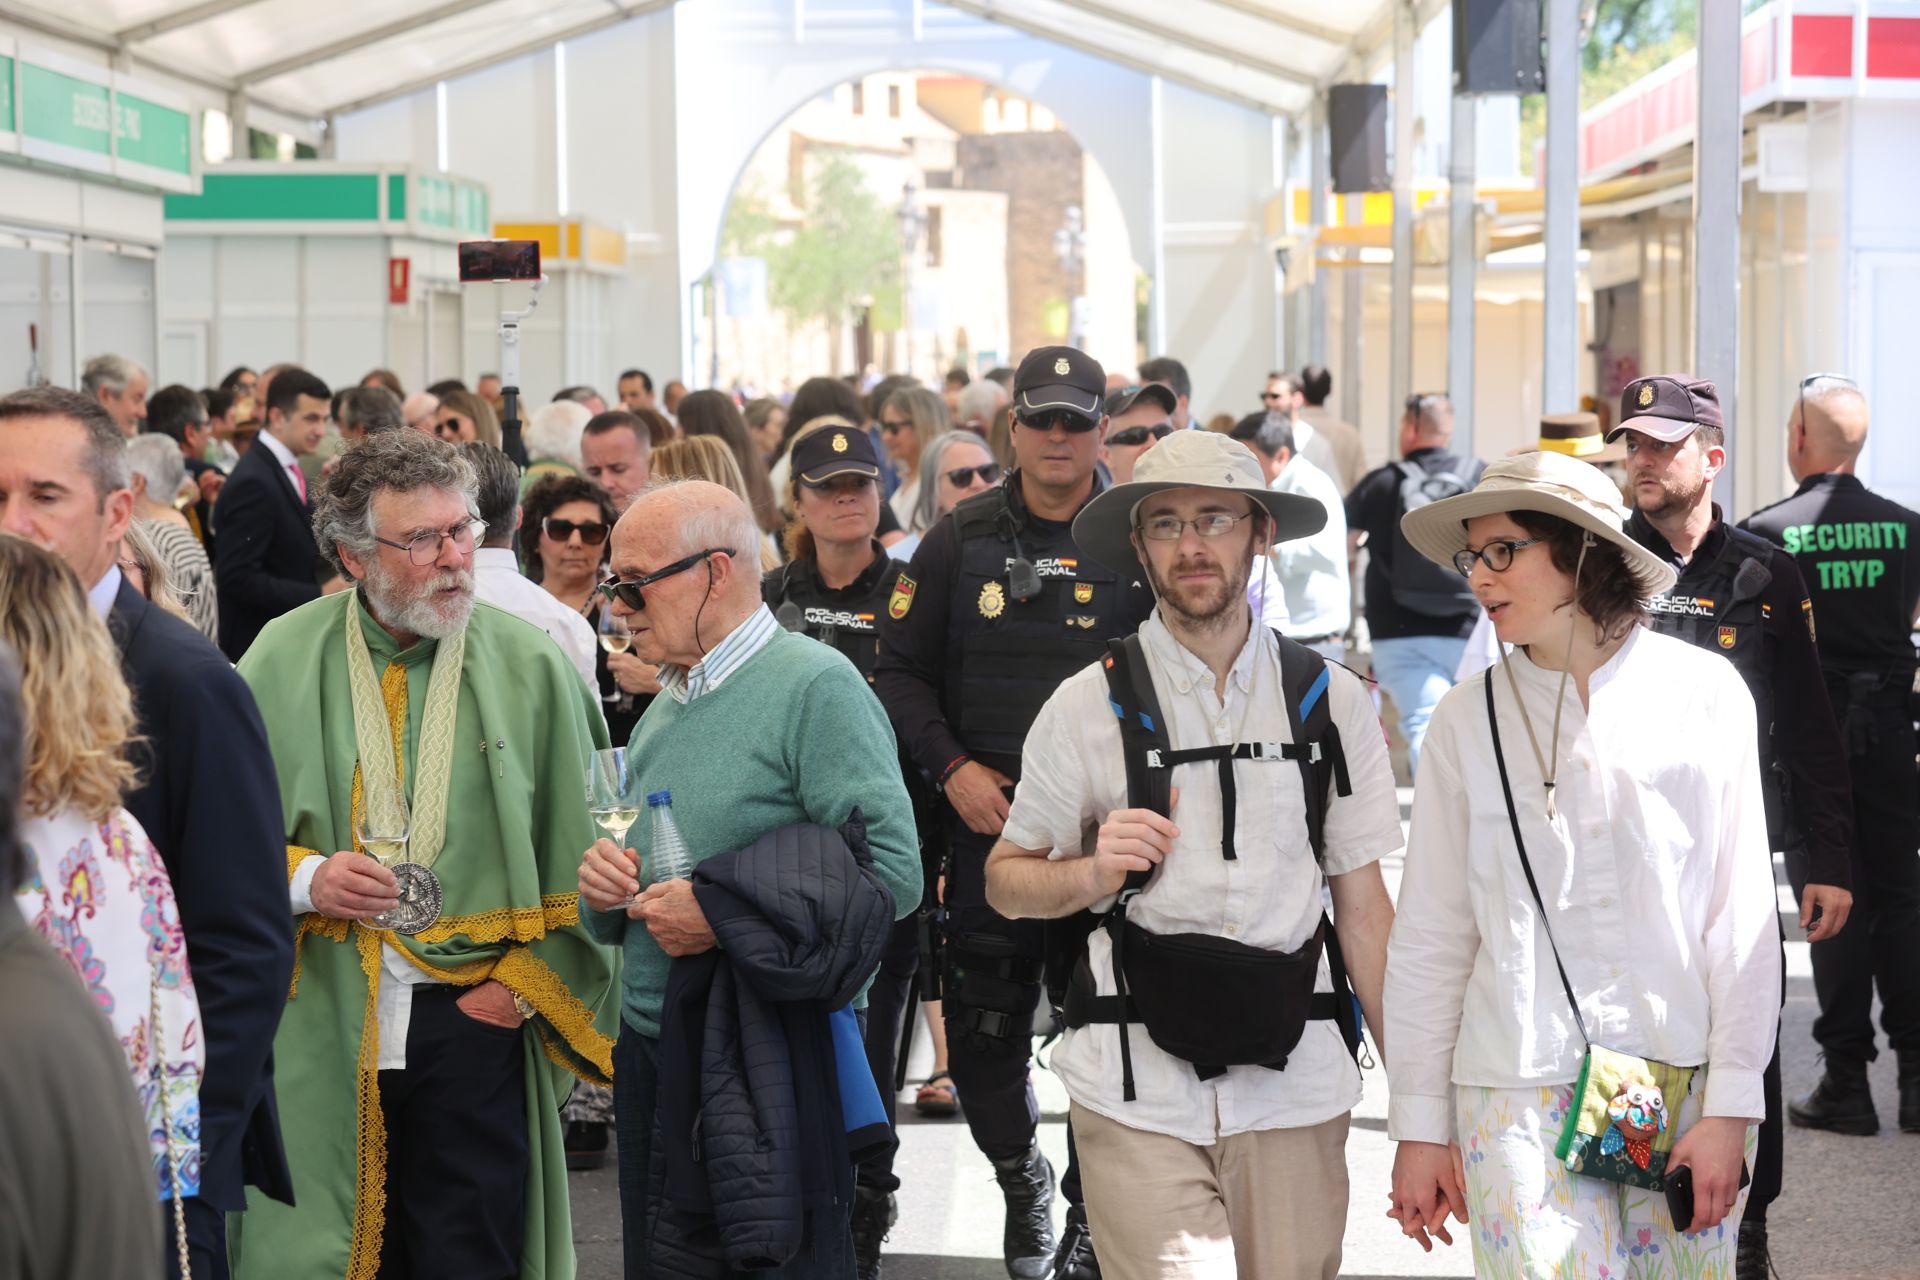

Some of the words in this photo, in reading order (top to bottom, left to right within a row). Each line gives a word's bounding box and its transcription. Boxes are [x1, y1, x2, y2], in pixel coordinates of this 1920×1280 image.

[1782, 522, 1906, 554] SECURITY
[1005, 557, 1062, 568] PICIA
[1816, 560, 1885, 590] TRYP
[1650, 594, 1699, 606] OLICIA
[804, 607, 860, 621] POLICIA
[804, 615, 874, 629] NACIONAL
